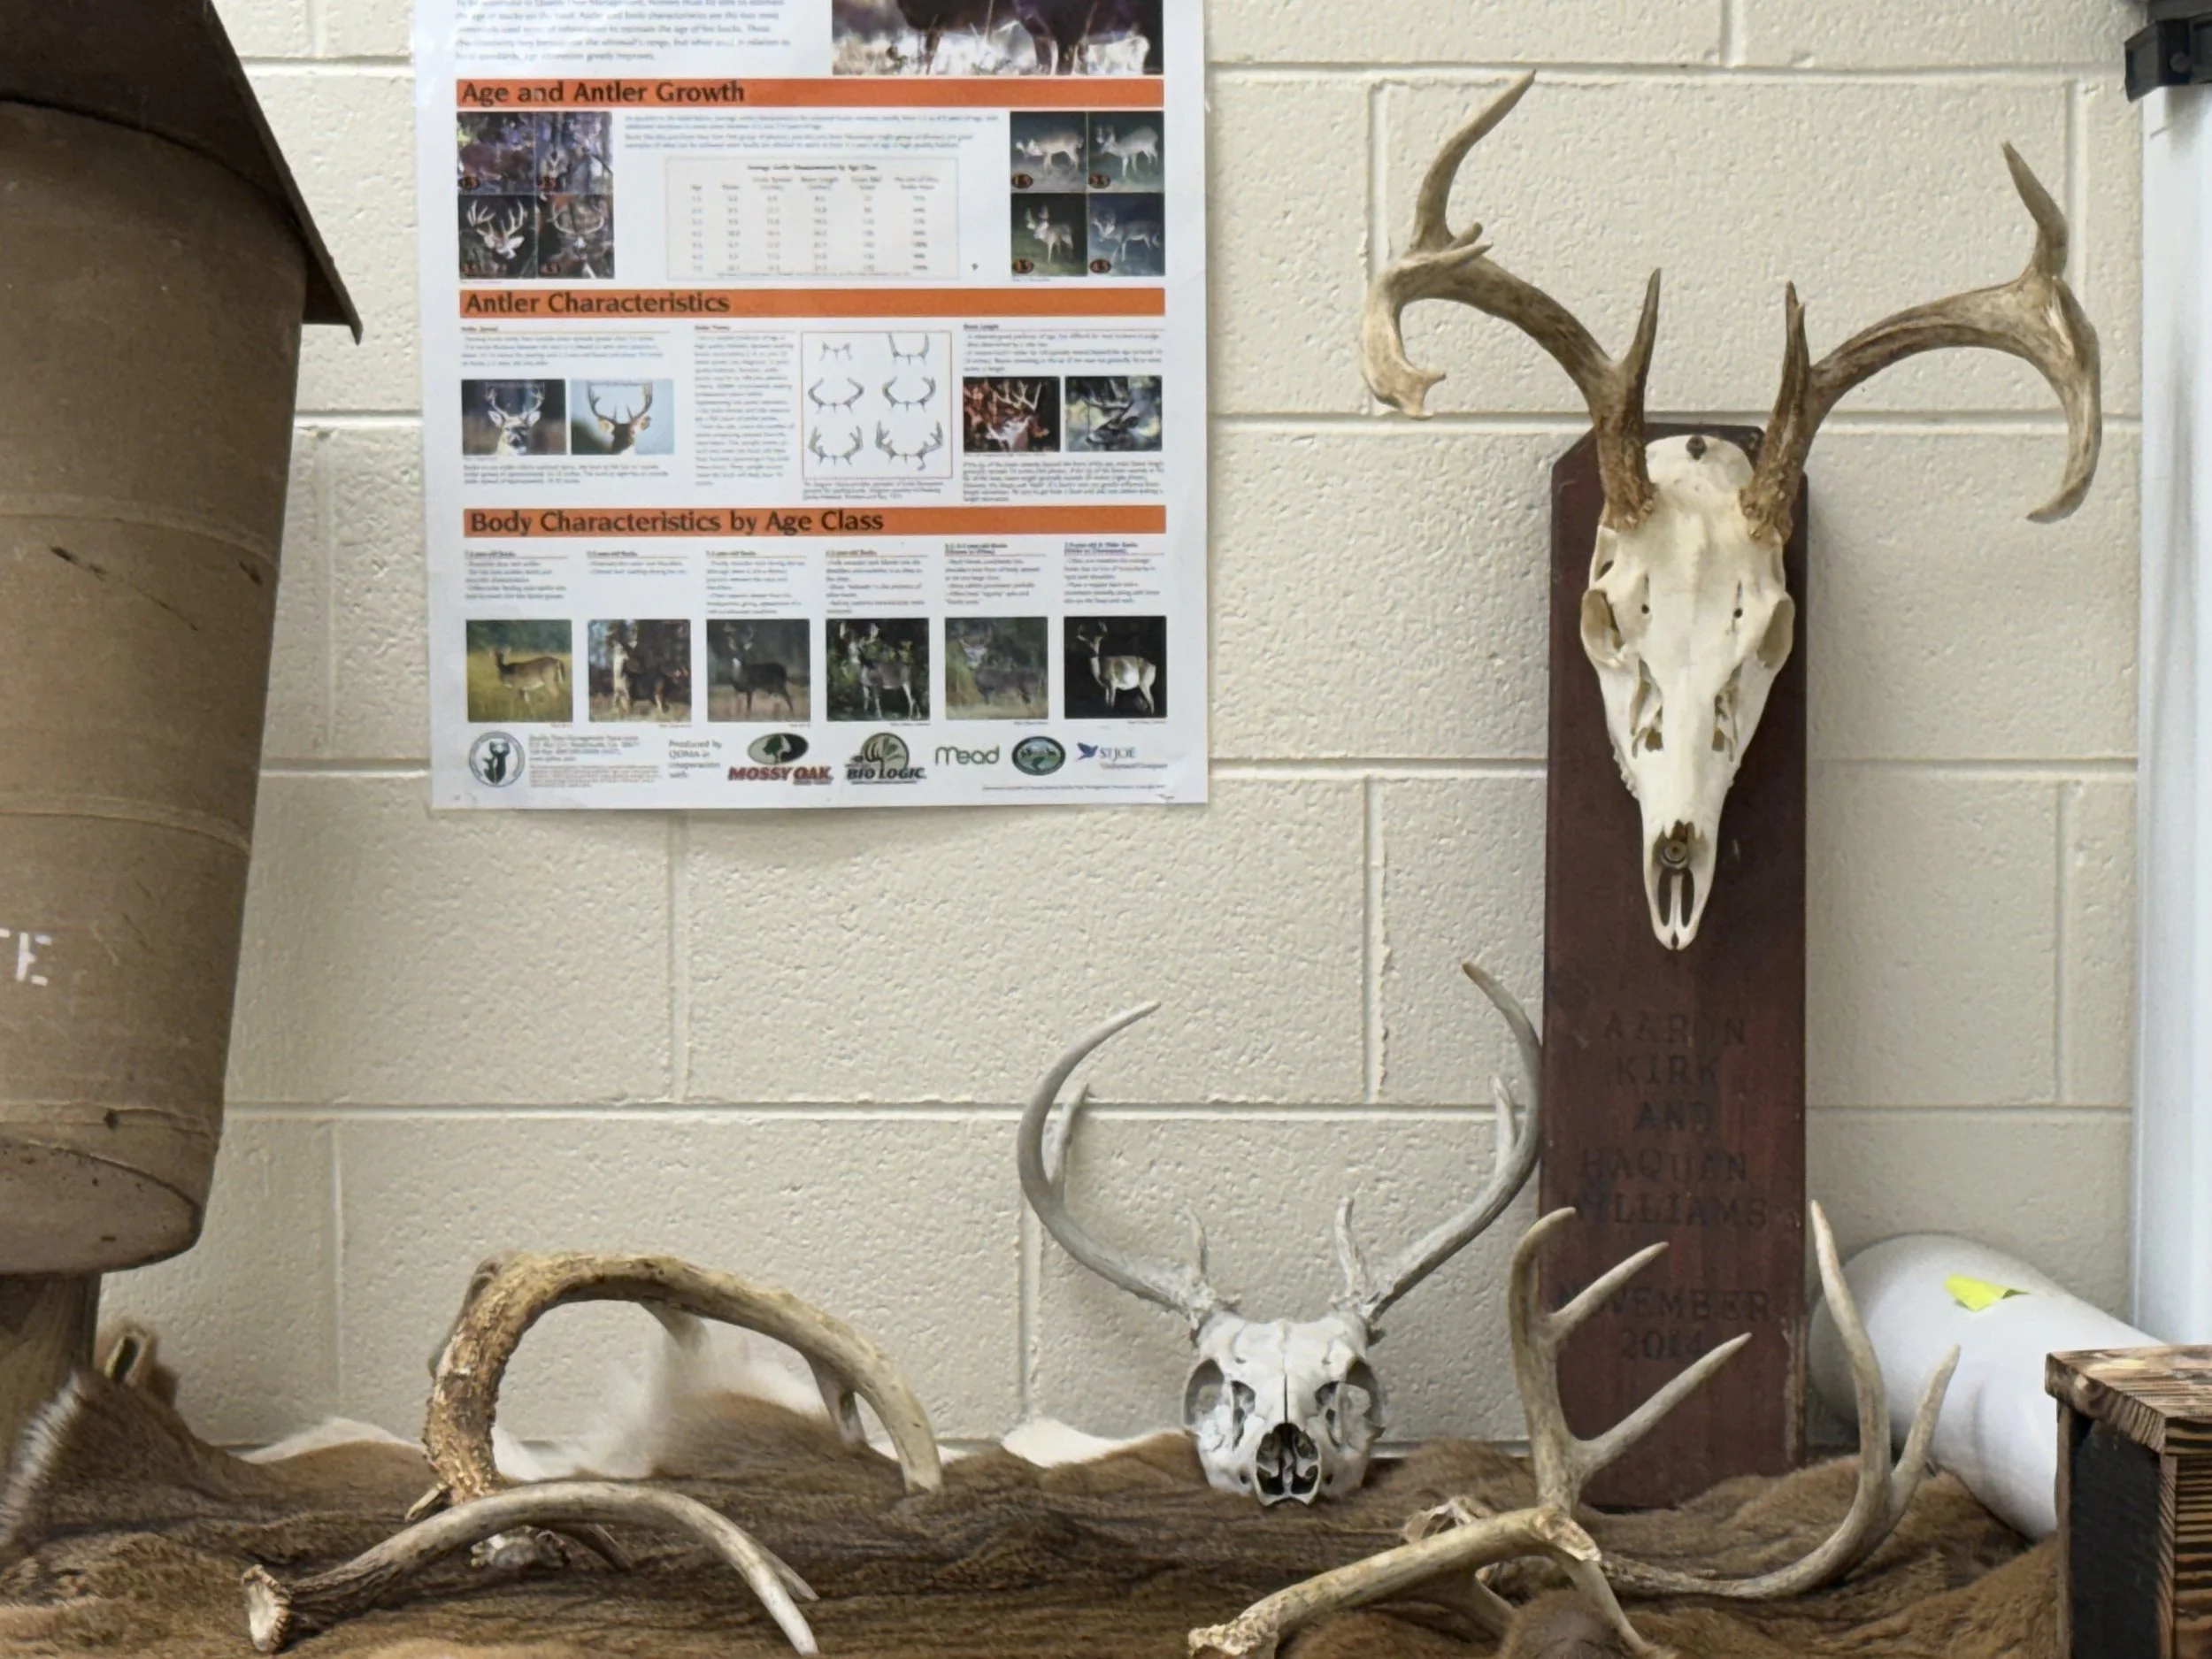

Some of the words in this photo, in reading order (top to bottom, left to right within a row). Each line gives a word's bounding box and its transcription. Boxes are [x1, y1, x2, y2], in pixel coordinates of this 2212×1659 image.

[461, 81, 509, 107] Age
[518, 81, 564, 103] and
[573, 81, 648, 103] Antler
[655, 80, 744, 103] Growth
[466, 291, 539, 314] Antler
[547, 290, 730, 313] Characteristics
[470, 510, 532, 536] Body
[540, 510, 721, 533] Characteristics
[730, 510, 757, 536] by
[765, 510, 812, 536] Age
[821, 509, 884, 531] Class
[727, 766, 793, 780] MOSSY
[846, 767, 875, 780] BIO
[878, 766, 926, 780] LOGIC
[0, 927, 52, 987] E
[1615, 1053, 1717, 1087] KIRK
[1632, 1100, 1715, 1133] AND
[1557, 1284, 1770, 1323] NVEMBER
